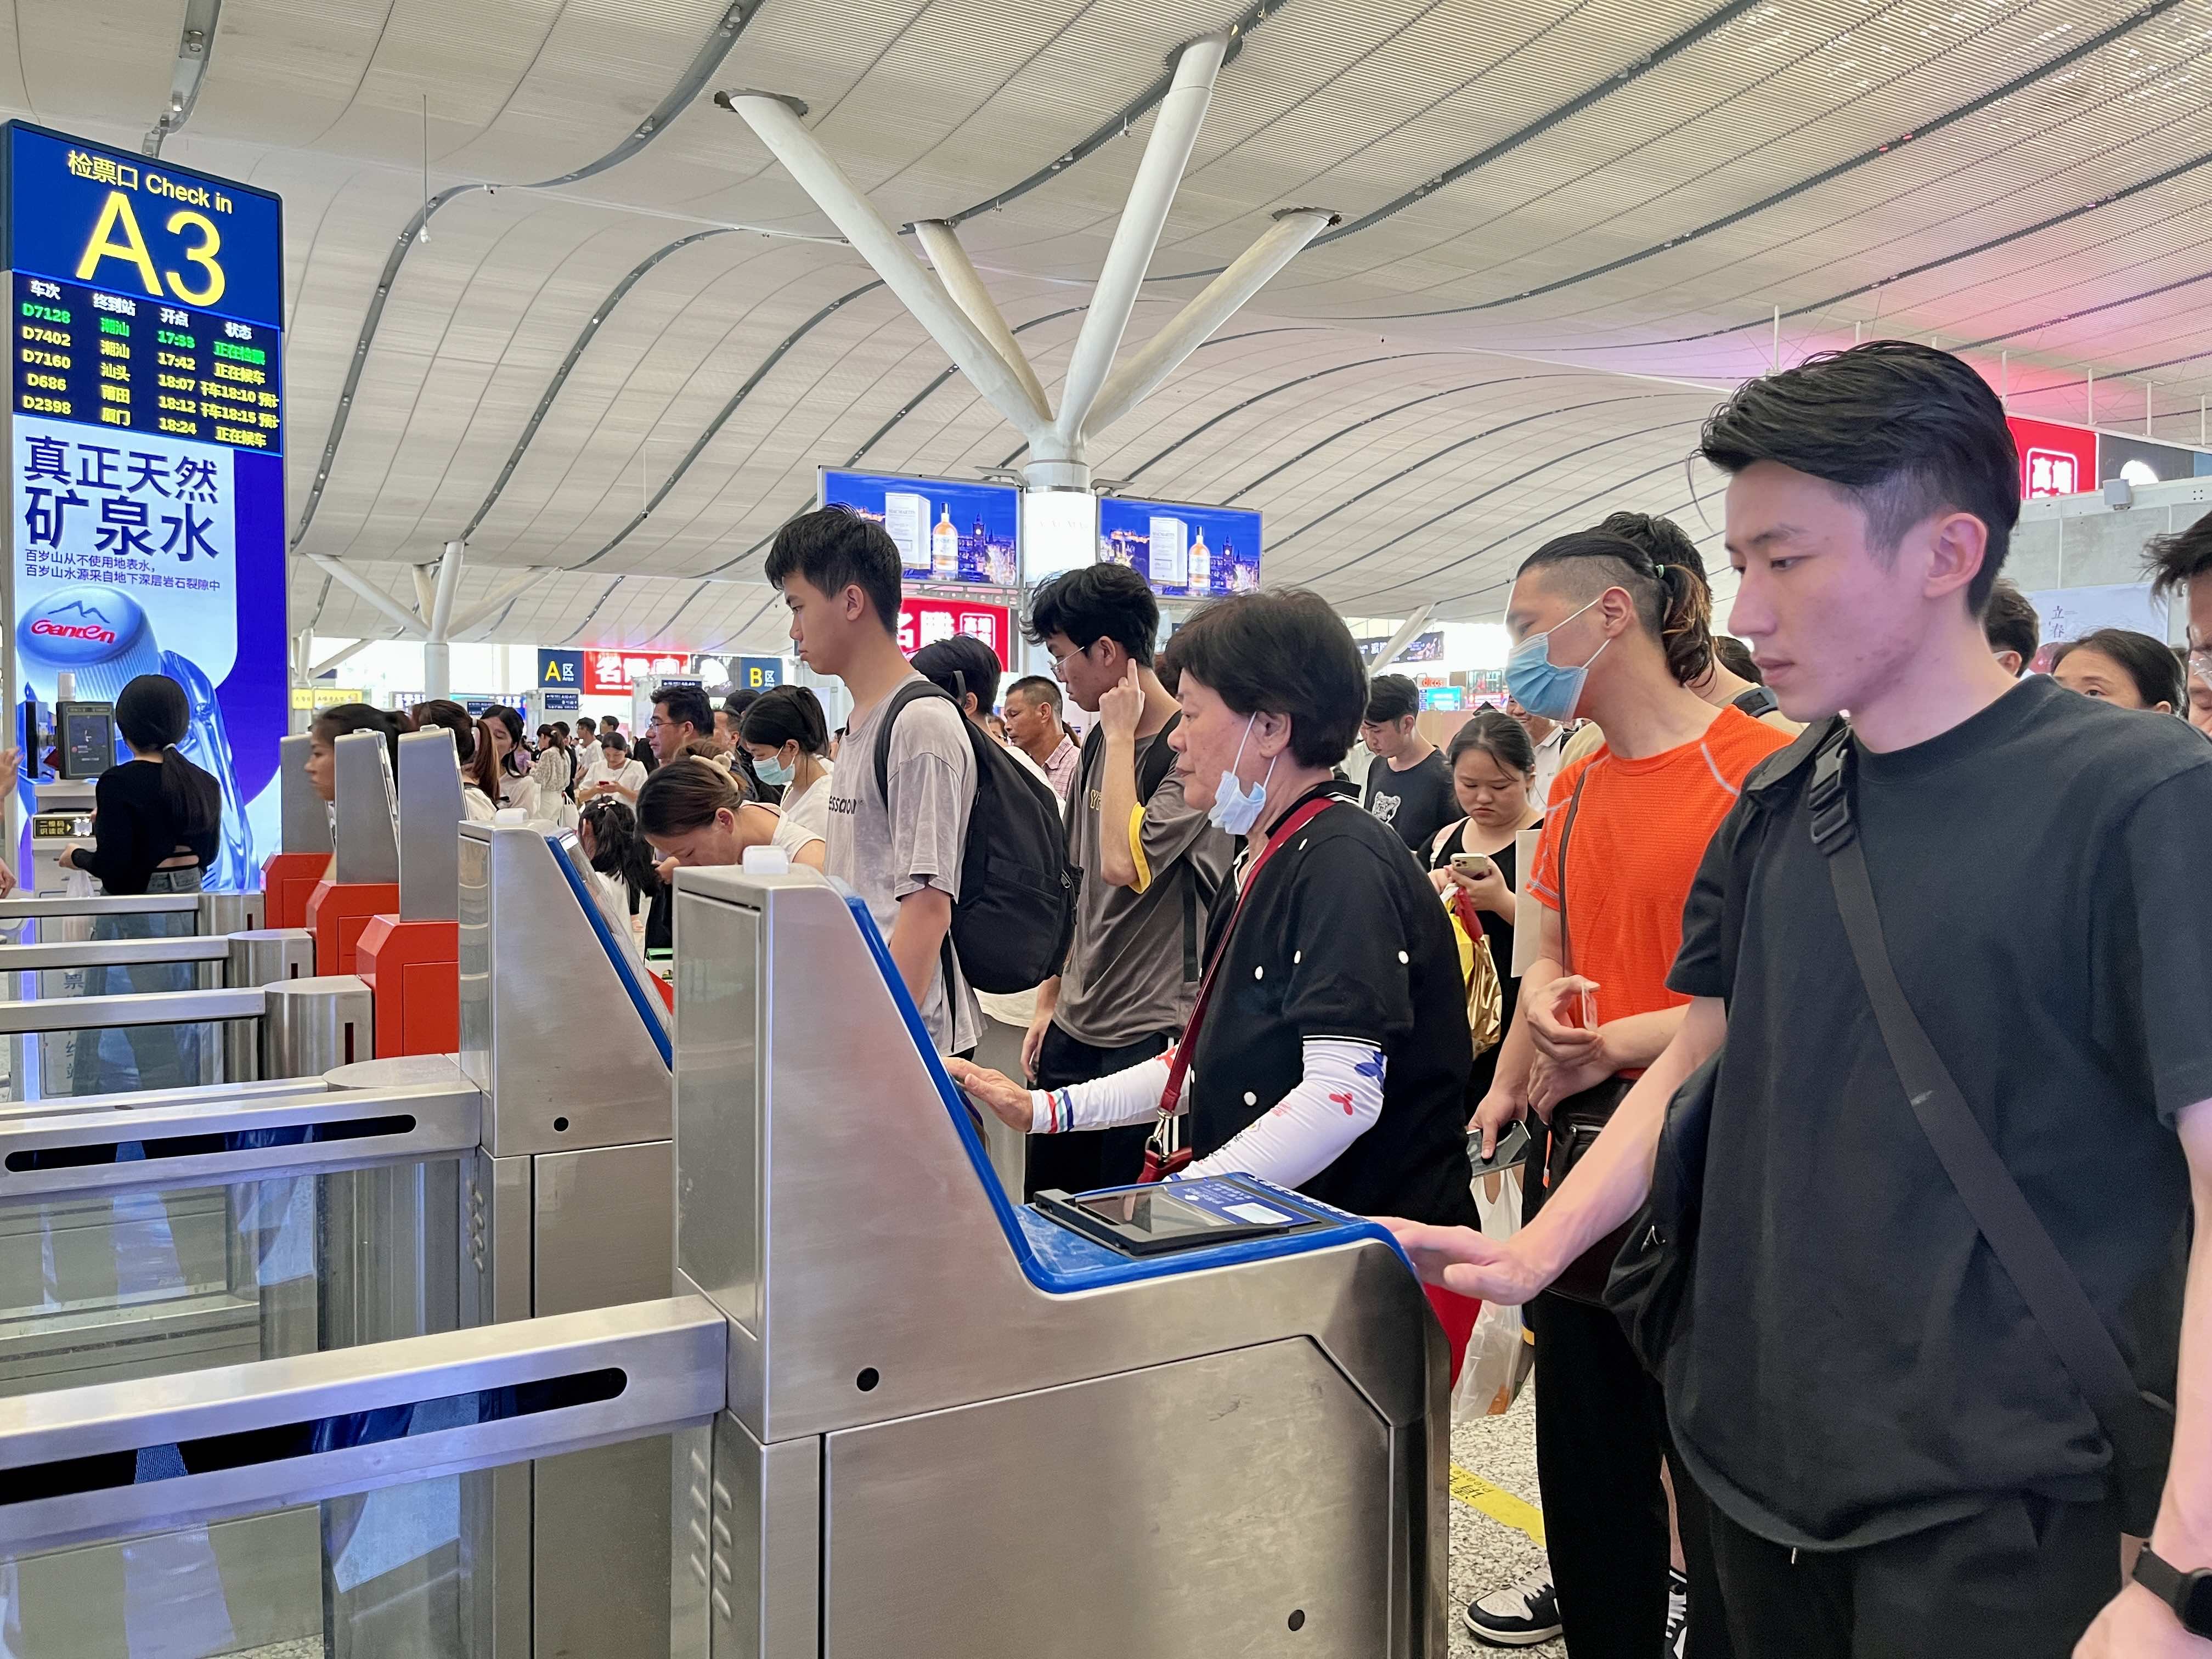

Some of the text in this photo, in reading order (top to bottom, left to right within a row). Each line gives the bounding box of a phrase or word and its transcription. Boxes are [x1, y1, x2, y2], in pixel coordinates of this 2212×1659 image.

[68, 150, 232, 214] 检票口 Check in
[76, 190, 226, 307] A3
[22, 303, 71, 324] D7128
[30, 280, 60, 300] 车次
[160, 307, 189, 327] 开点
[224, 321, 252, 340] 状态
[22, 326, 71, 347] D7402
[157, 352, 195, 370] 17:42
[214, 362, 266, 385] 正在候车
[22, 349, 71, 369] D7160
[100, 362, 131, 382] 汕头
[159, 374, 195, 392] 18:07
[22, 395, 71, 415] D2398
[159, 417, 197, 435] 18:24
[215, 426, 266, 448] 正在候车
[27, 373, 66, 391] D686
[159, 396, 196, 414] 18:12
[24, 436, 219, 505] 真正天然
[24, 486, 219, 562] 矿泉水
[25, 564, 220, 591] 百岁山水源来自地下深层岩石裂隙中
[31, 619, 115, 644] Ganten
